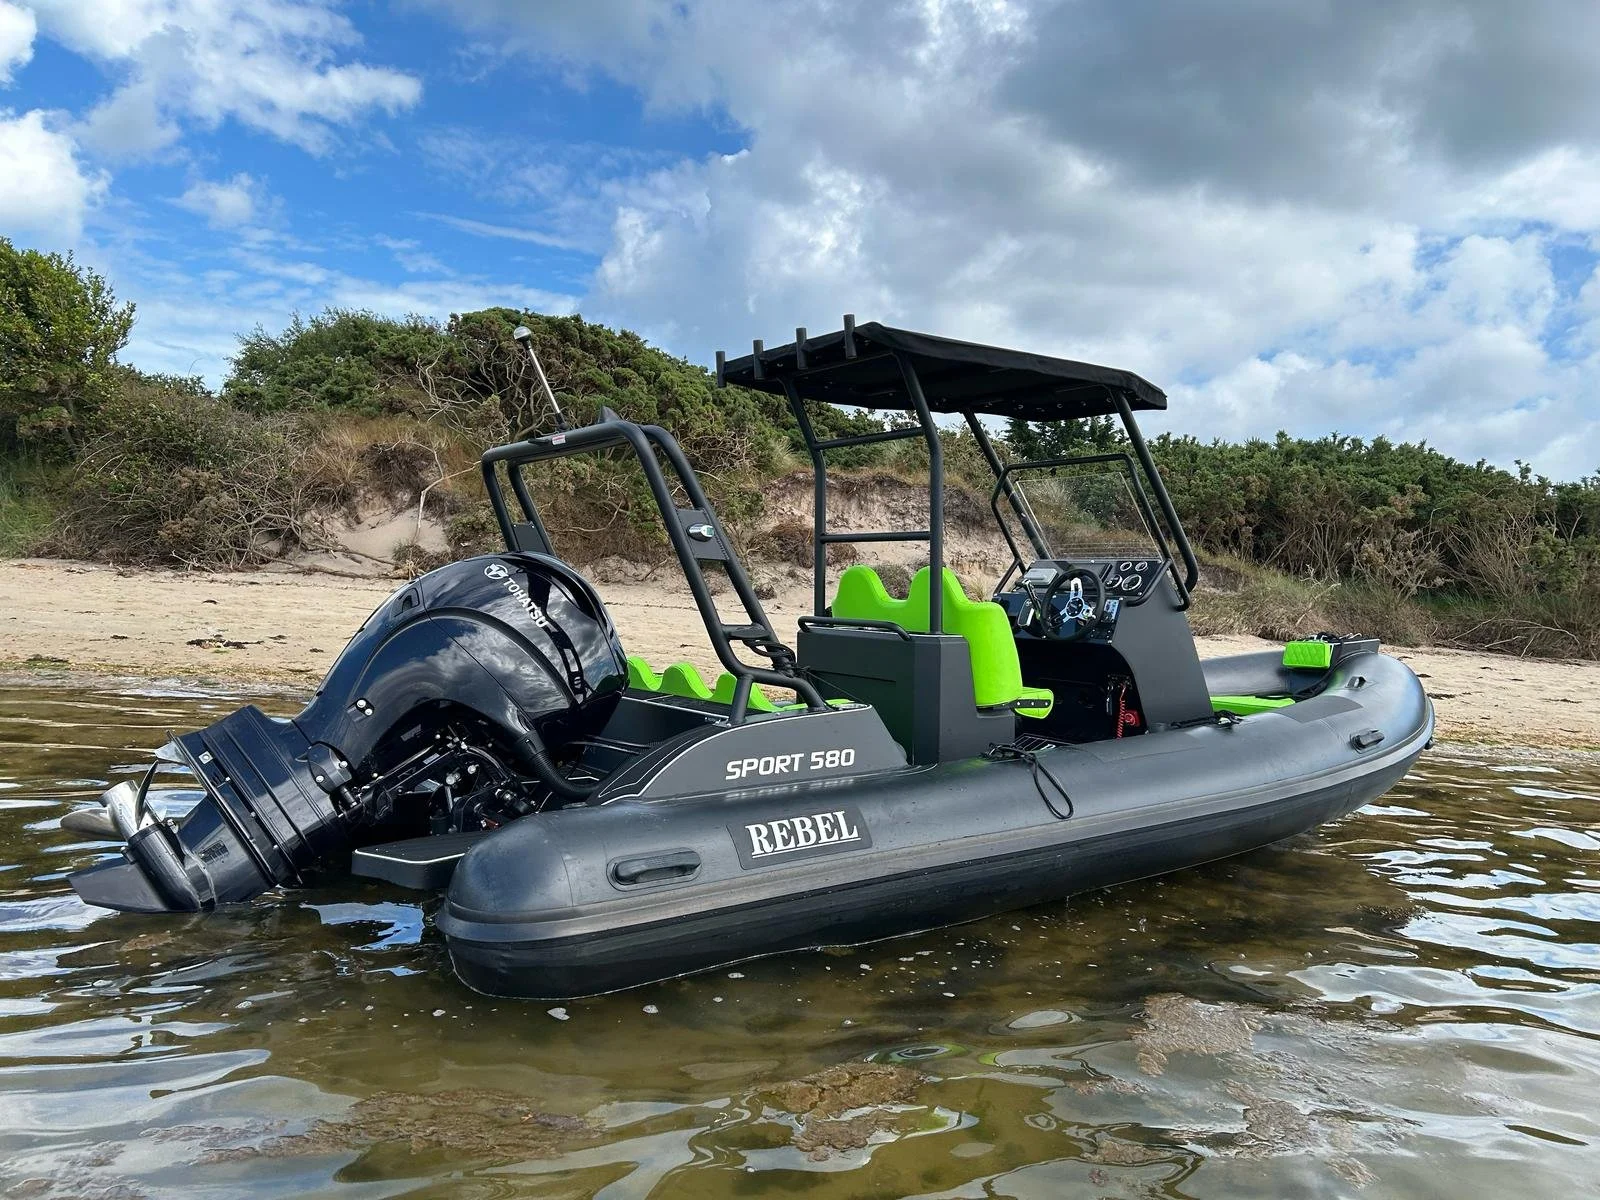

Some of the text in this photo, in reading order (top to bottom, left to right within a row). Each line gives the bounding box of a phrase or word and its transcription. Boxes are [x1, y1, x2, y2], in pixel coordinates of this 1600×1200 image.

[503, 577, 550, 628] TOHATSU
[725, 749, 855, 780] SPORT 580
[745, 811, 859, 856] REBEL
